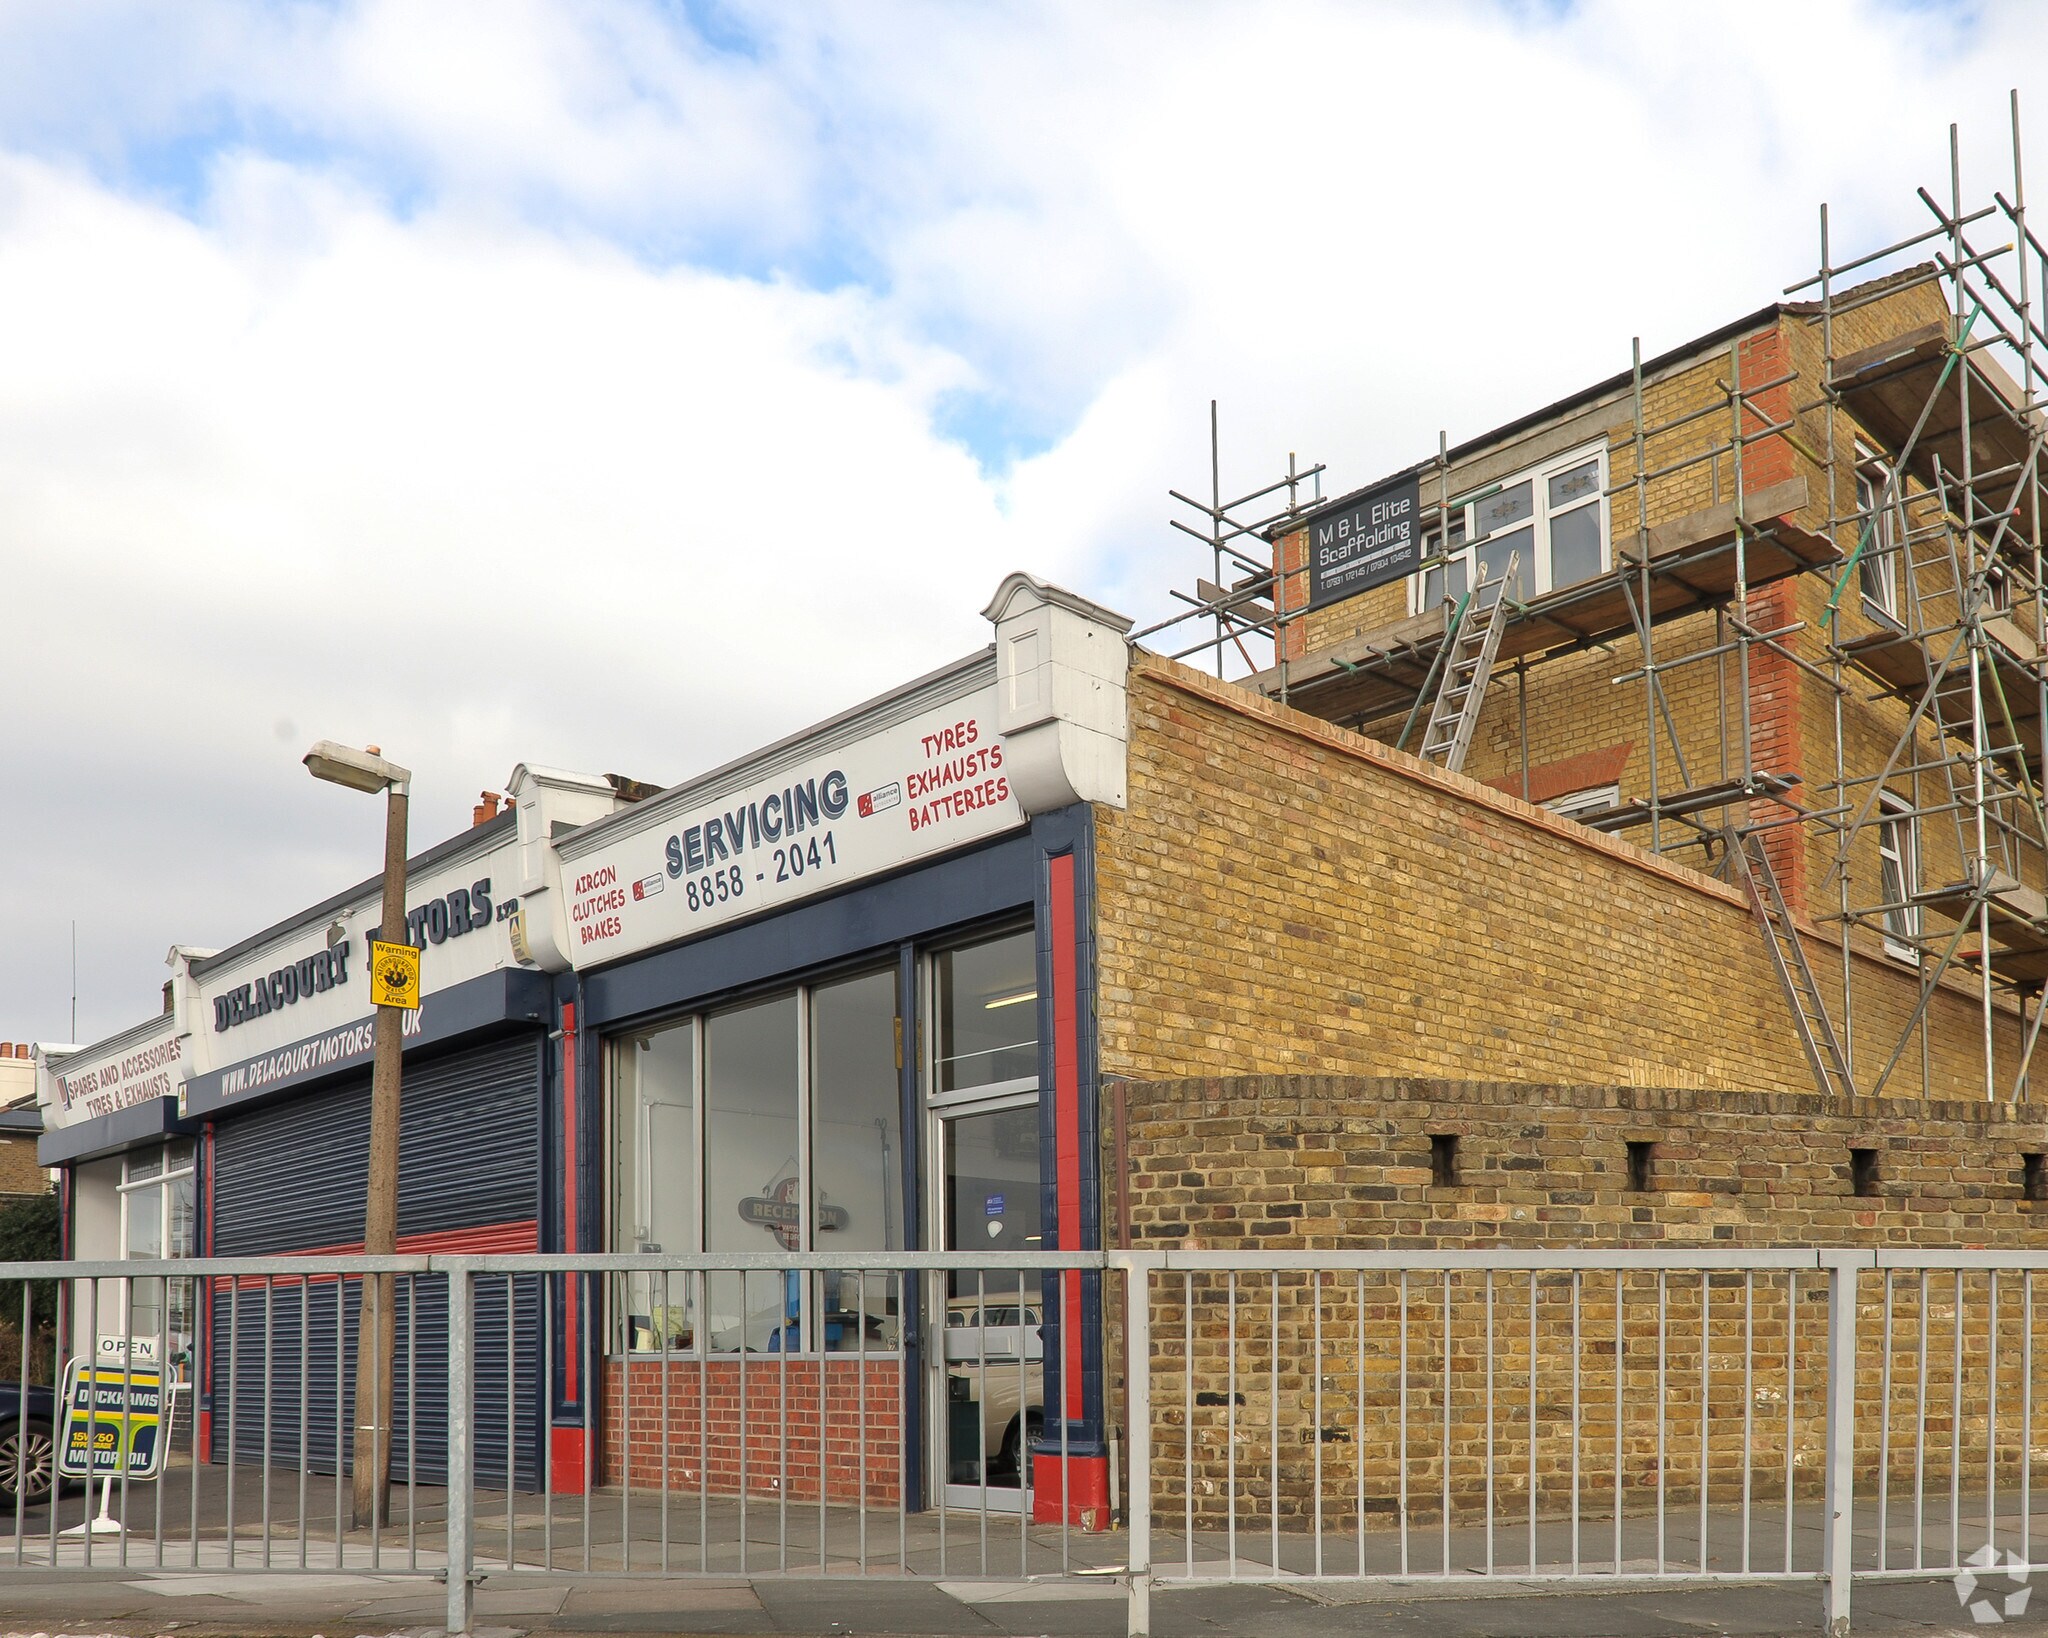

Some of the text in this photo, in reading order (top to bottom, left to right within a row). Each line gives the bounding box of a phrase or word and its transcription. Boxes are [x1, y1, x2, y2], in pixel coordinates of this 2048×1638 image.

[1319, 498, 1411, 546] M & L Elite
[1319, 520, 1411, 567] Scaffolding
[921, 719, 979, 759] TYRES
[906, 744, 1003, 800] EXHAUSTS
[873, 787, 899, 802] alliance
[908, 777, 1009, 832] BATTERIES
[665, 769, 849, 880] SERVICING
[575, 864, 617, 896] AIRCON
[685, 864, 744, 912] 8858
[772, 830, 837, 883] 2041
[572, 888, 626, 922] CLUTCHES
[376, 943, 417, 959] Warning
[580, 916, 622, 945] BRAKES
[213, 877, 519, 1033] DELACOURT TORS LTD
[385, 994, 407, 1004] Area
[67, 1036, 182, 1101] SPARES AND ACCESSORIES
[86, 1094, 113, 1119] TYRES
[115, 1090, 124, 1110] &
[124, 1071, 171, 1108] EXHAUSTS
[753, 1203, 838, 1224] RECEPON
[102, 1339, 152, 1355] OPEN
